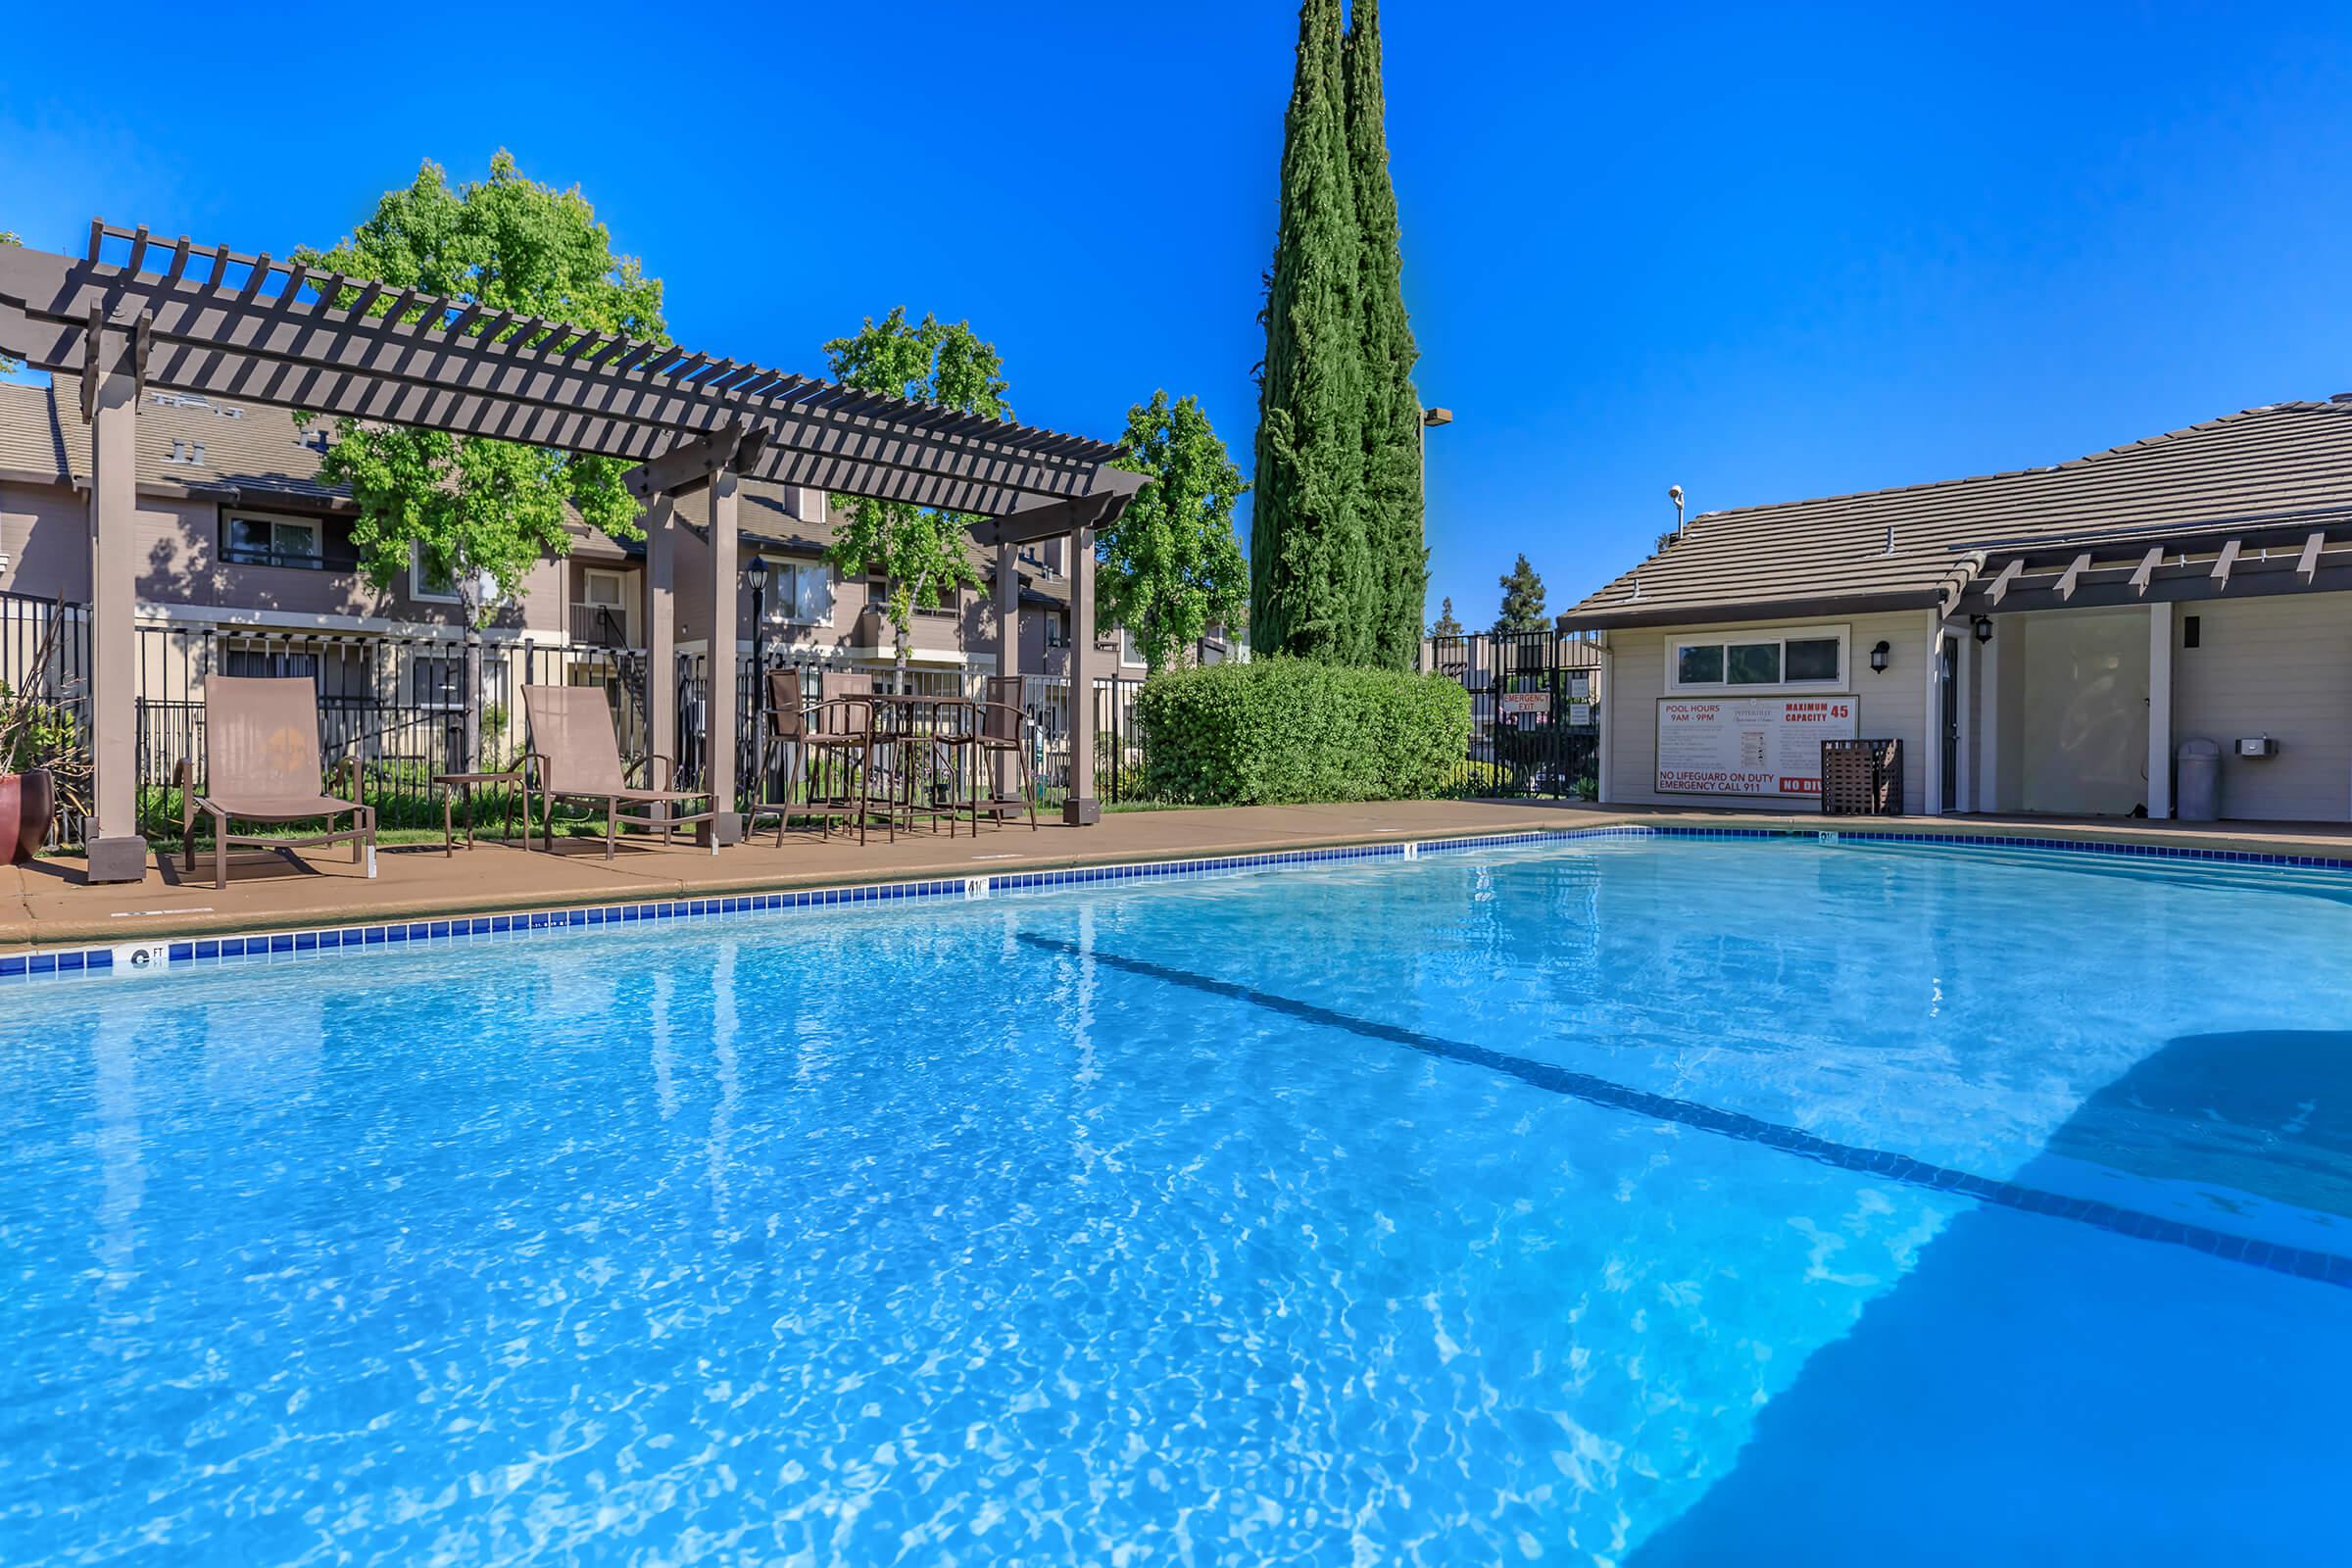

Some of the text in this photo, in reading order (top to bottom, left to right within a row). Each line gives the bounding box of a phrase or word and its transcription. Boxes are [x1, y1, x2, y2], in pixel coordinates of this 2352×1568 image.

[1504, 694, 1549, 703] EMERGENCY
[1786, 703, 1828, 711] MAXIMUM
[1831, 705, 1848, 717] 45
[1676, 771, 1727, 782] LIFEGUARD
[1730, 773, 1745, 782] ON
[1747, 773, 1775, 783] DUTY
[1659, 780, 1760, 792] EMERGENCY CALL 911
[1784, 779, 1799, 791] NO
[153, 947, 164, 957] FT
